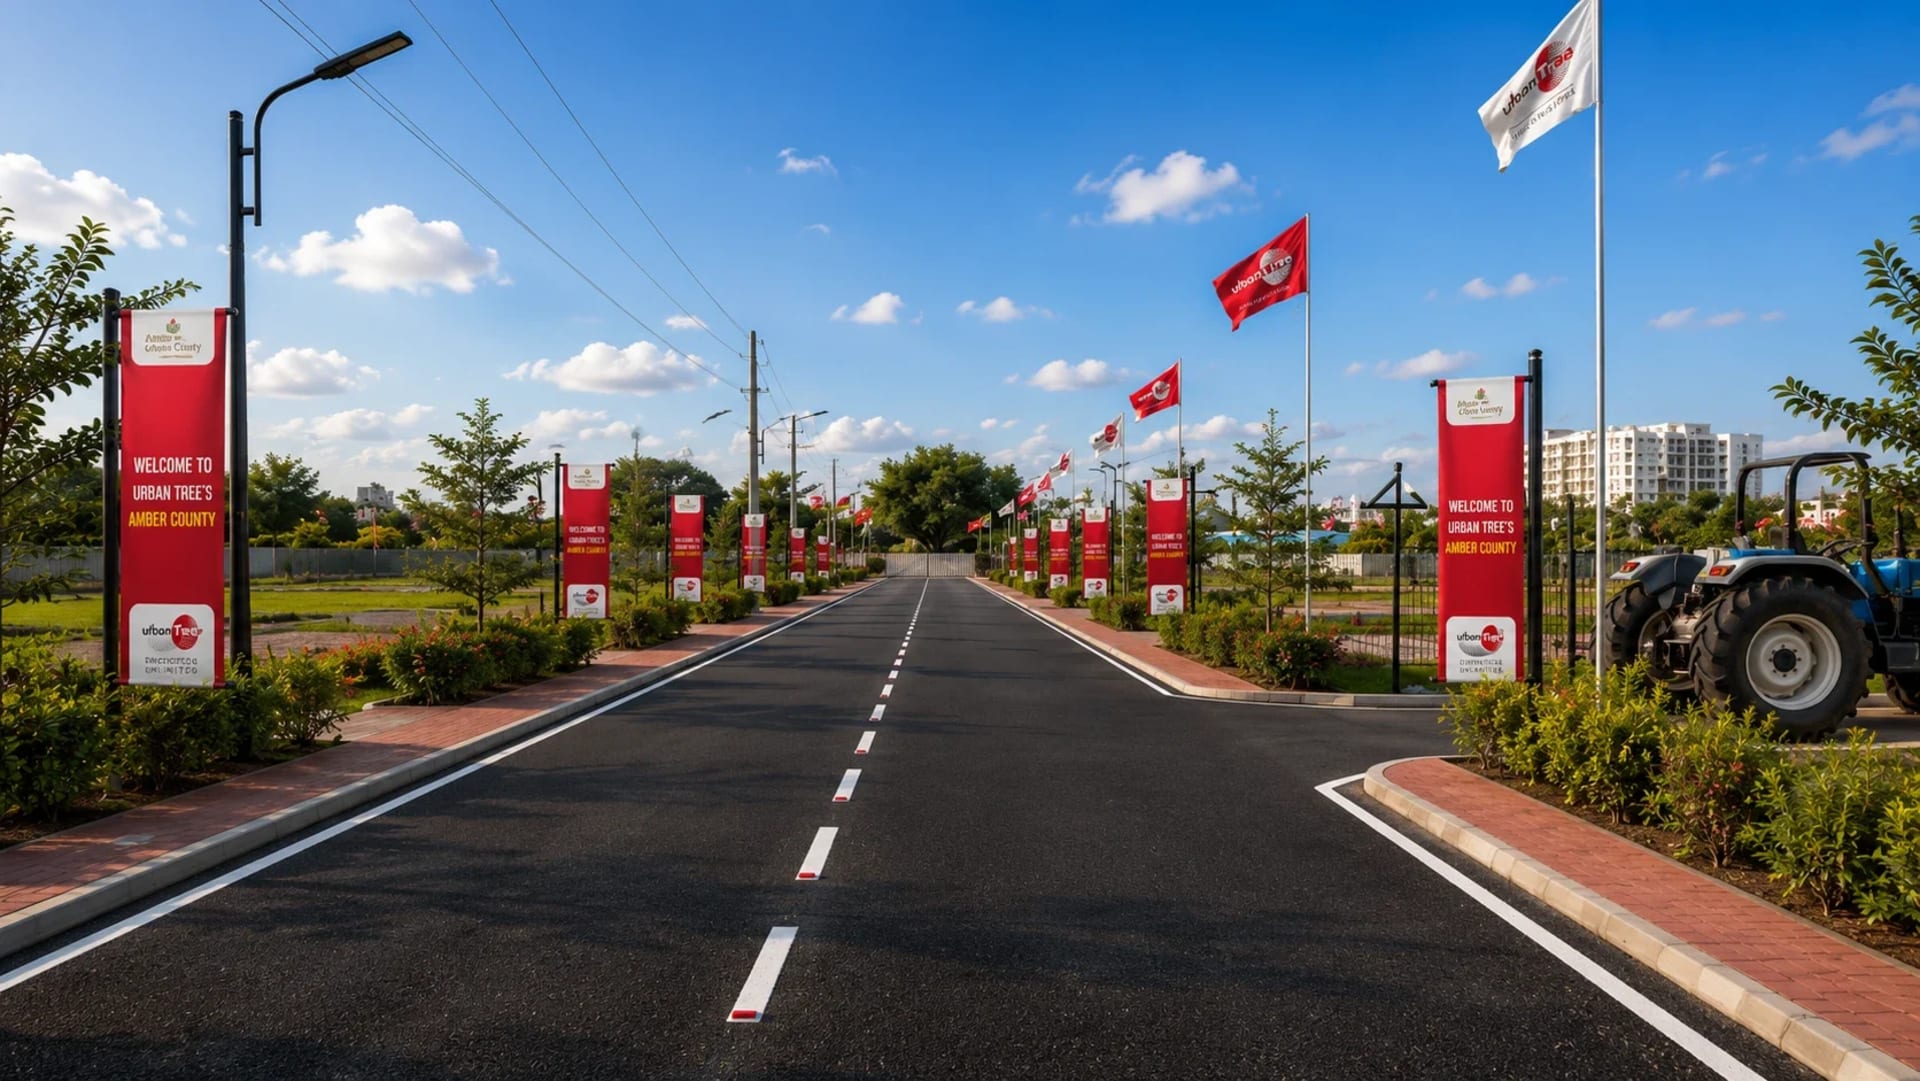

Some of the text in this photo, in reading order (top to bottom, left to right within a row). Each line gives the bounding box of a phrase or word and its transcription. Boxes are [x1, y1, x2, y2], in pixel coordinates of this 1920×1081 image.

[133, 456, 212, 473] WELCOME TO
[133, 484, 213, 501] URBAN TREE'S
[1448, 499, 1514, 513] WELCOME TO
[128, 511, 216, 527] AMBER COUNTY
[1448, 520, 1515, 534] URBAN TREE'S
[1445, 541, 1517, 554] AMBER COUNTY
